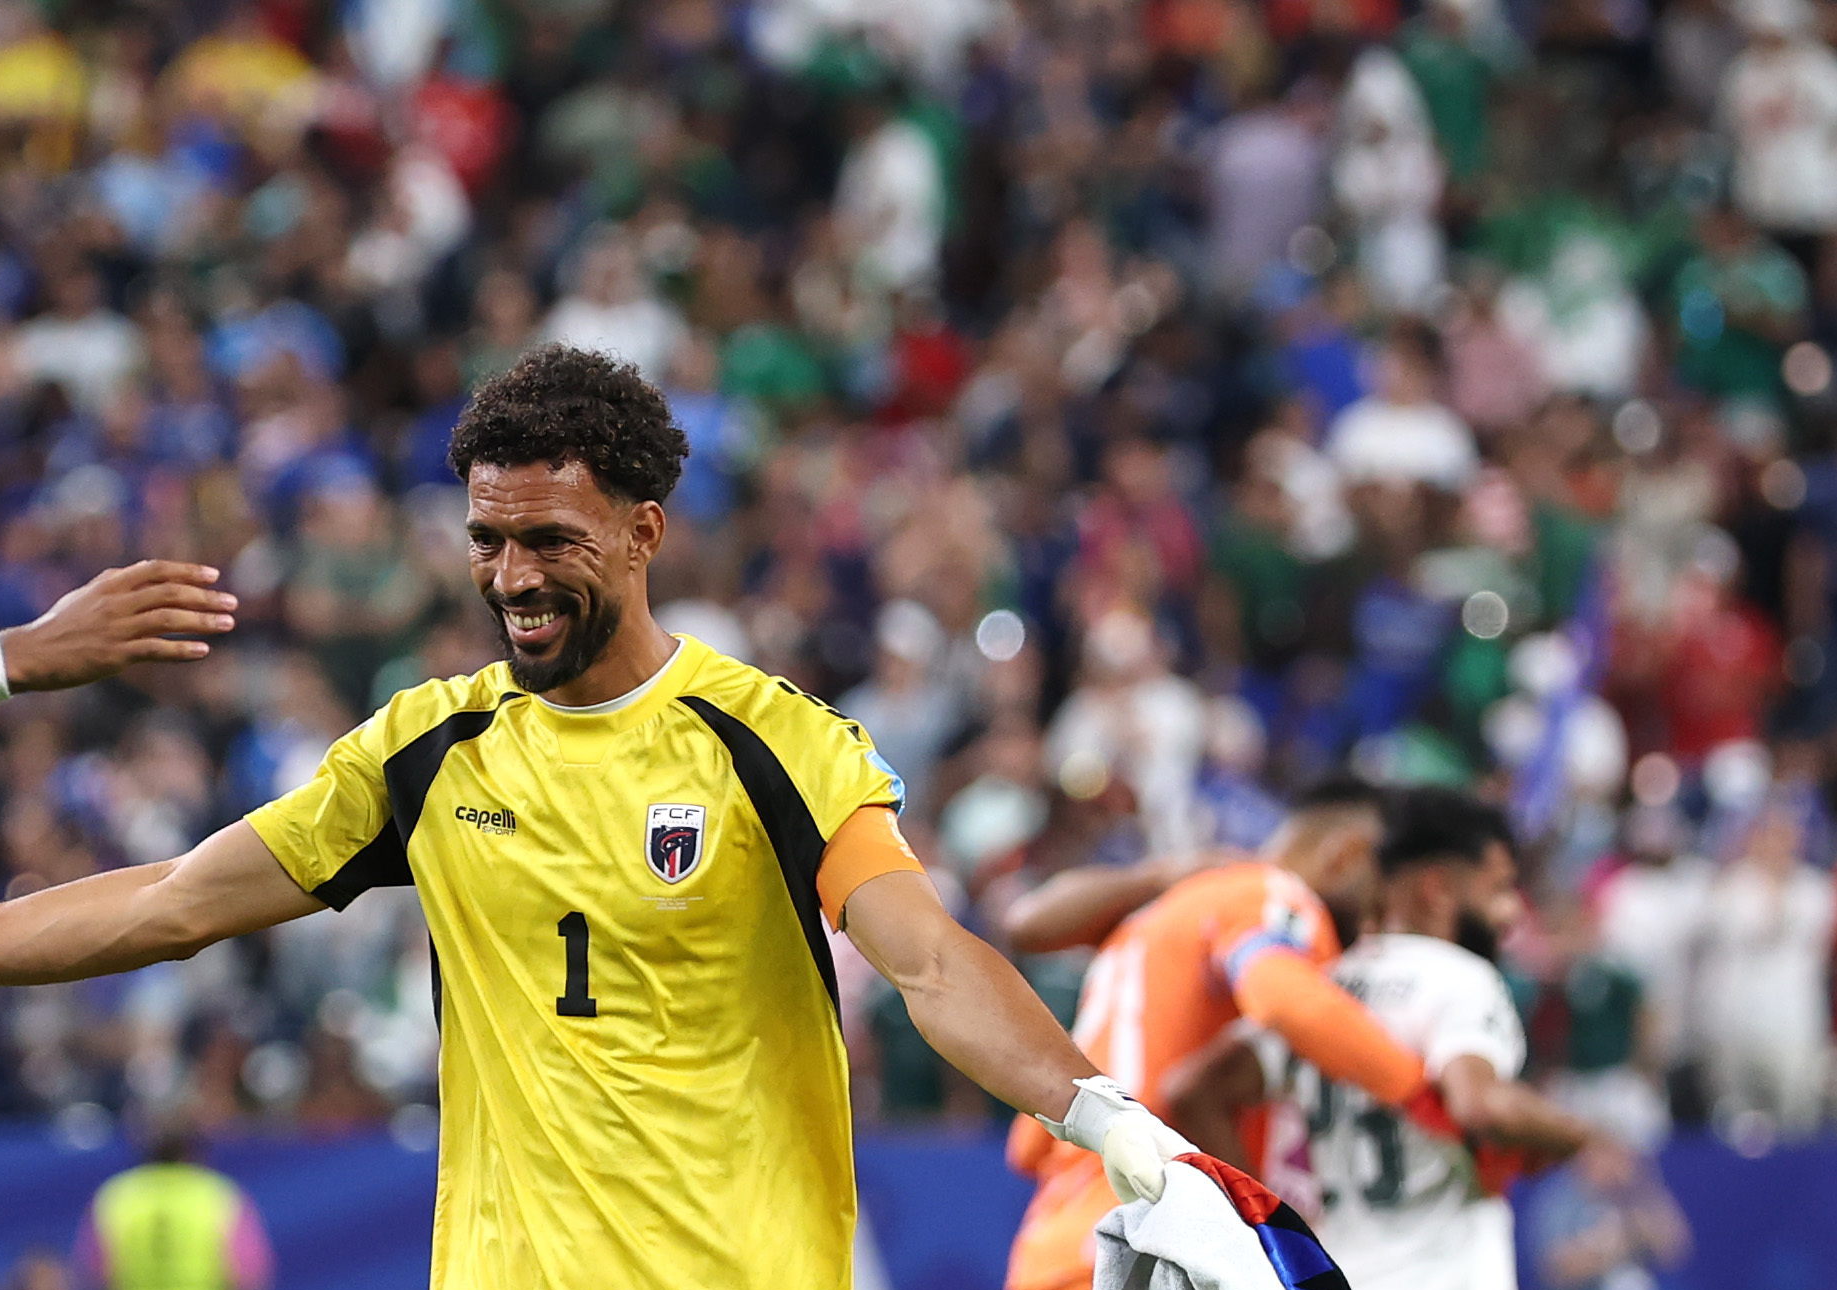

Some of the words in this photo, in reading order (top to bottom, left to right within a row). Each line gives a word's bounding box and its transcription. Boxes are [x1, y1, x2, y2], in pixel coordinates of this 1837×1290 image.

[455, 806, 517, 829] capelli
[653, 807, 700, 820] FCF
[556, 911, 597, 1017] 1
